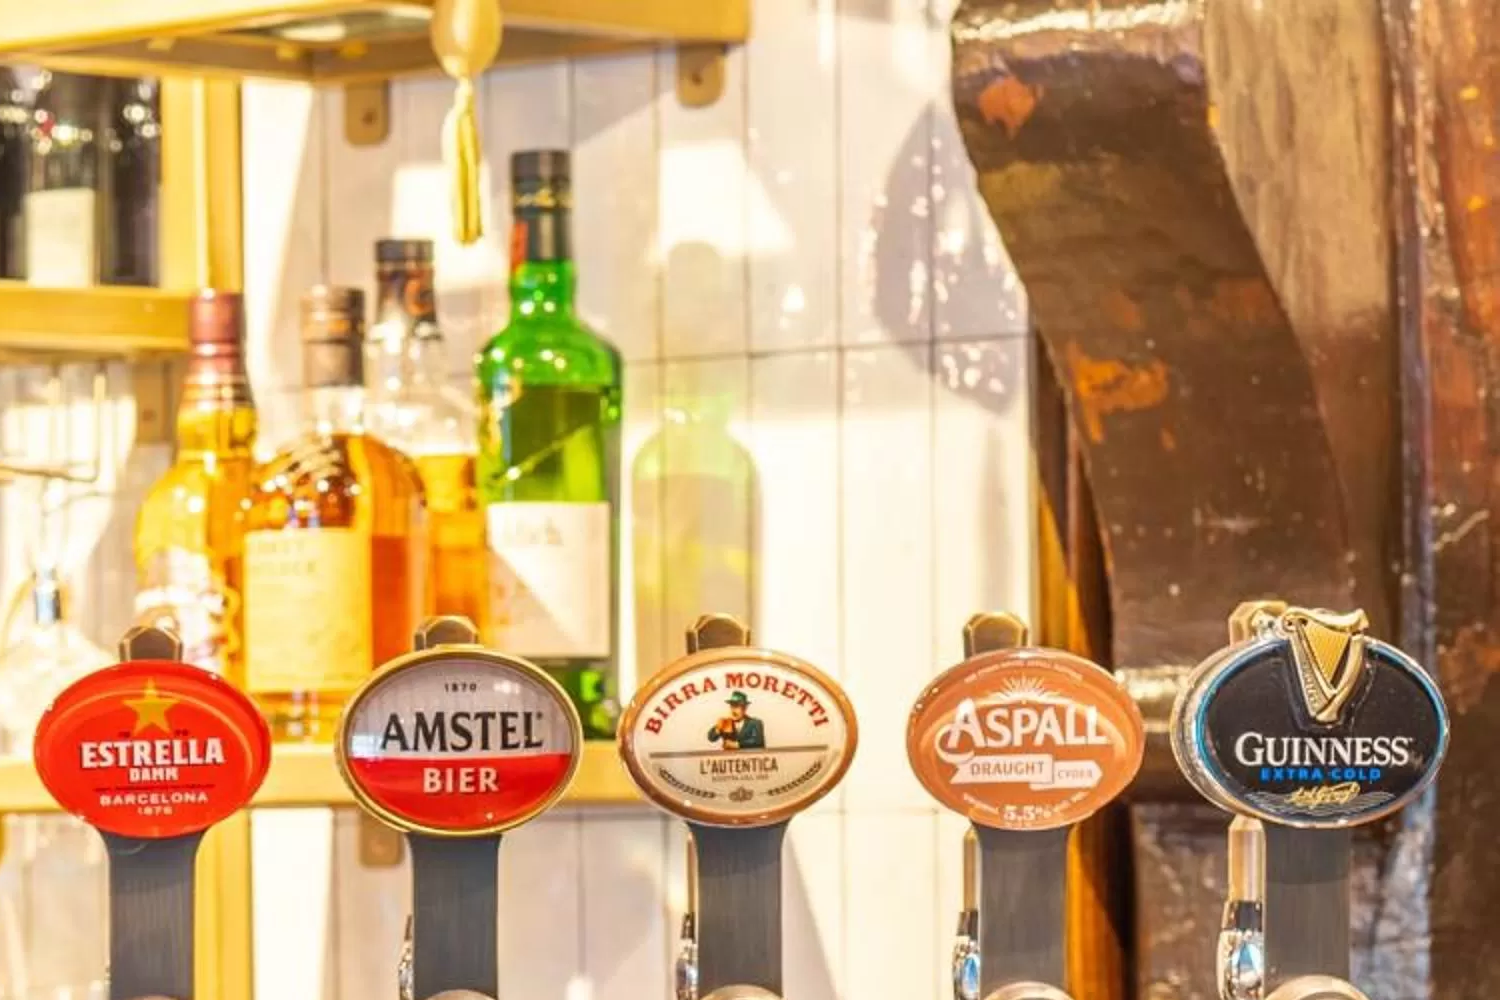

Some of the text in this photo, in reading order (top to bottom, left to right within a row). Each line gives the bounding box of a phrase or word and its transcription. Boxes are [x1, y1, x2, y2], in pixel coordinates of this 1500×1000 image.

[445, 683, 477, 692] 1870
[644, 672, 830, 735] BIRRA MORETTI
[381, 711, 543, 752] AMSTEL
[935, 698, 1109, 763] ASPALL
[81, 737, 224, 768] ESTRELLA
[1235, 731, 1409, 766] GUINNESS
[129, 767, 178, 782] DAMM
[700, 757, 778, 774] L'AUTENTICA
[970, 761, 1044, 775] DRAUGHT
[1260, 767, 1381, 781] EXTRA COLD
[423, 767, 499, 793] BIER
[100, 791, 208, 806] BARCELONA
